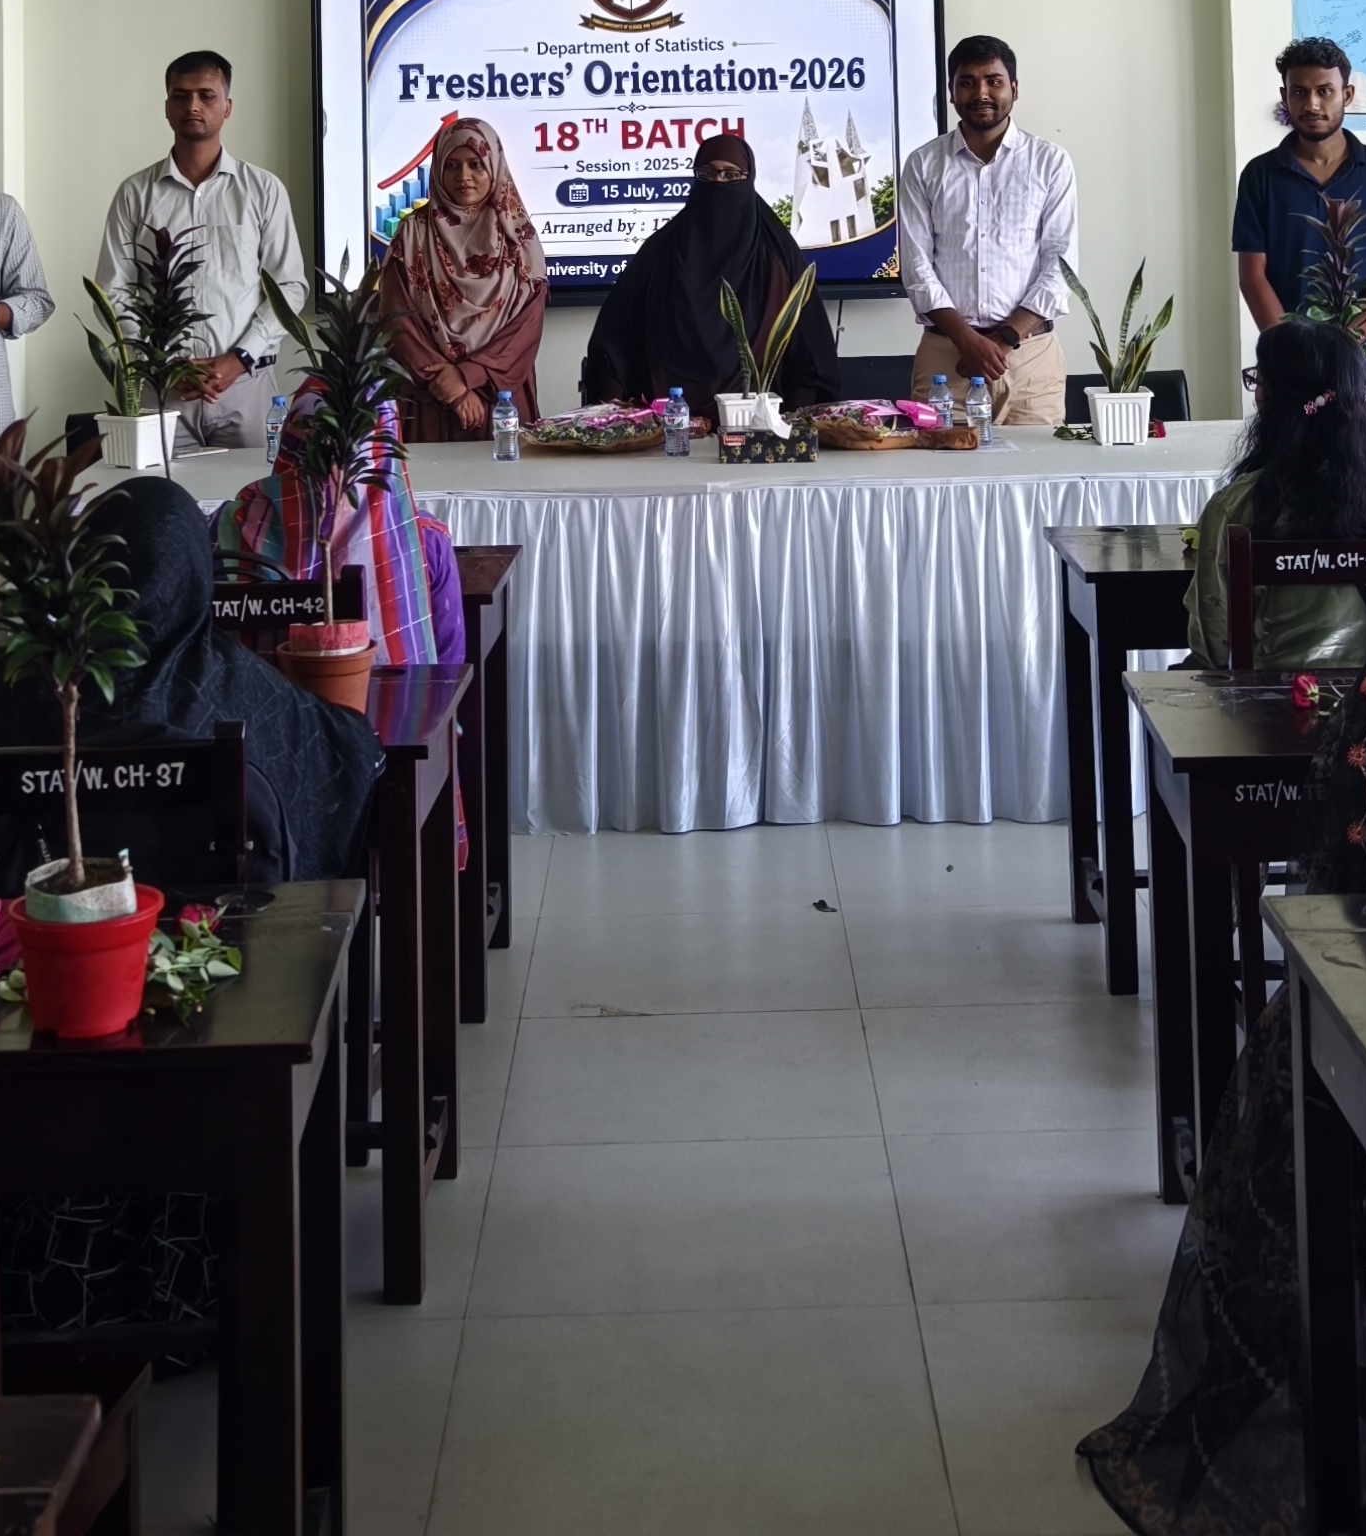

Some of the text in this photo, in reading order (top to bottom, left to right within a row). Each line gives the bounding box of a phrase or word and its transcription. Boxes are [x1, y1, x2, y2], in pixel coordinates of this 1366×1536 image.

[537, 37, 725, 58] Department of Statistics
[584, 56, 866, 96] Orientation-2026
[621, 117, 745, 150] BATCH
[576, 158, 631, 173] Session
[643, 157, 694, 171] 2025-2
[601, 183, 691, 201] 15 July, 202
[541, 218, 613, 237] Arranged
[618, 218, 636, 235] by
[652, 217, 673, 232] 17
[546, 260, 628, 278] niversity of
[1275, 548, 1336, 575] STAT/W.
[212, 594, 325, 622] TAT/W. CH-42
[21, 759, 185, 794] STA/W. CH-37
[1234, 779, 1302, 809] STAT/W.
